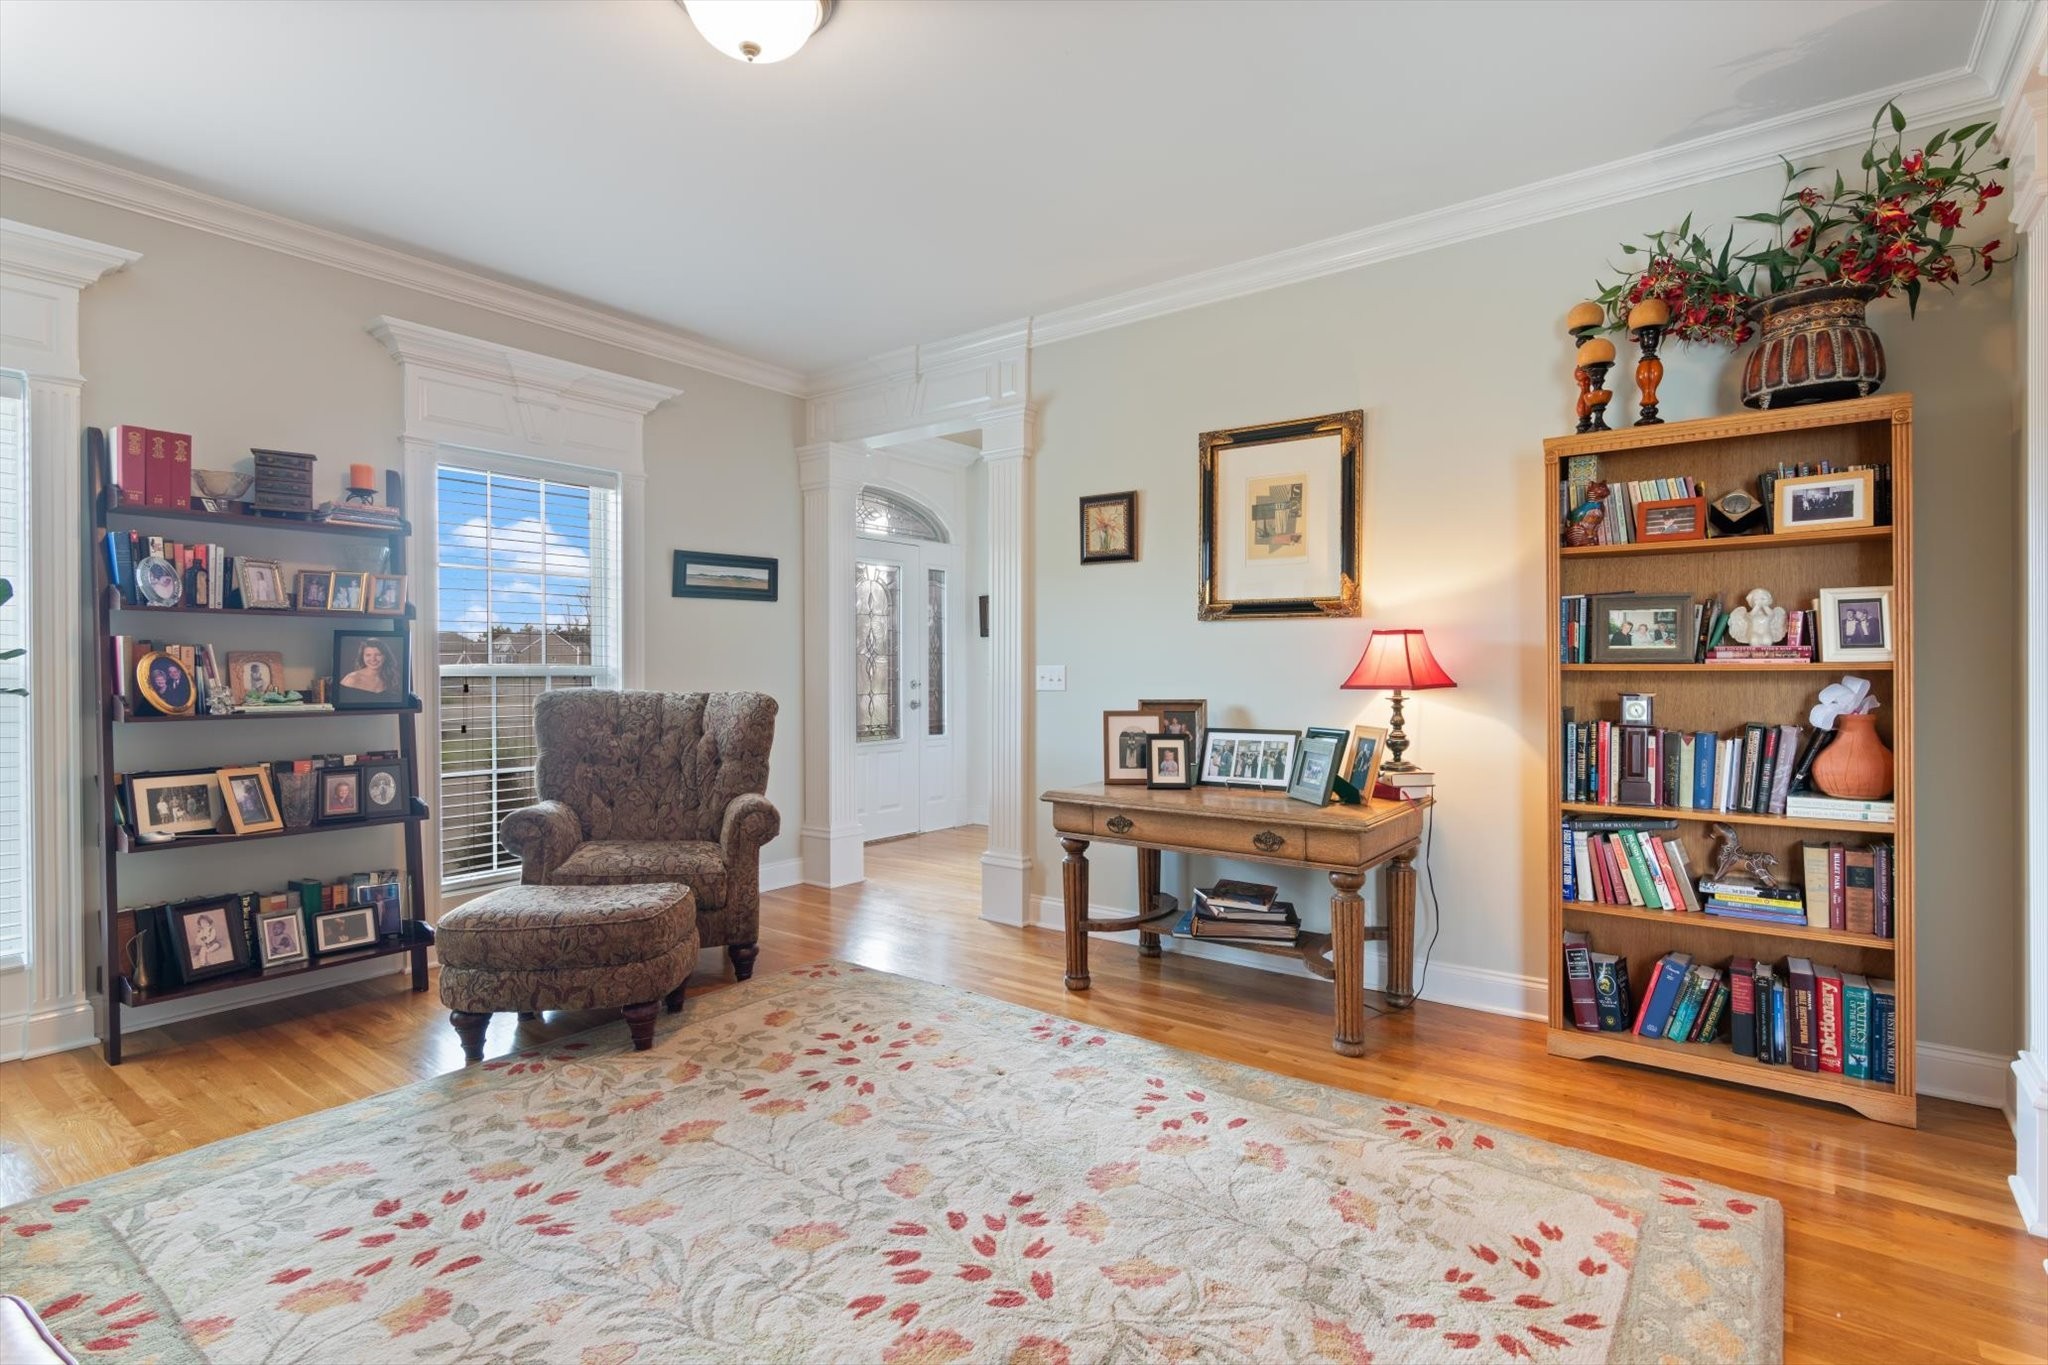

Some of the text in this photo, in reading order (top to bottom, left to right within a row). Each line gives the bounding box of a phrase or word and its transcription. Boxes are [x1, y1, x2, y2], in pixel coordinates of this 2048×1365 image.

[1820, 981, 1838, 1057] Dictionary
[1857, 1001, 1867, 1044] POLITICS
[1887, 1011, 1895, 1074] WESTERN WORLD
